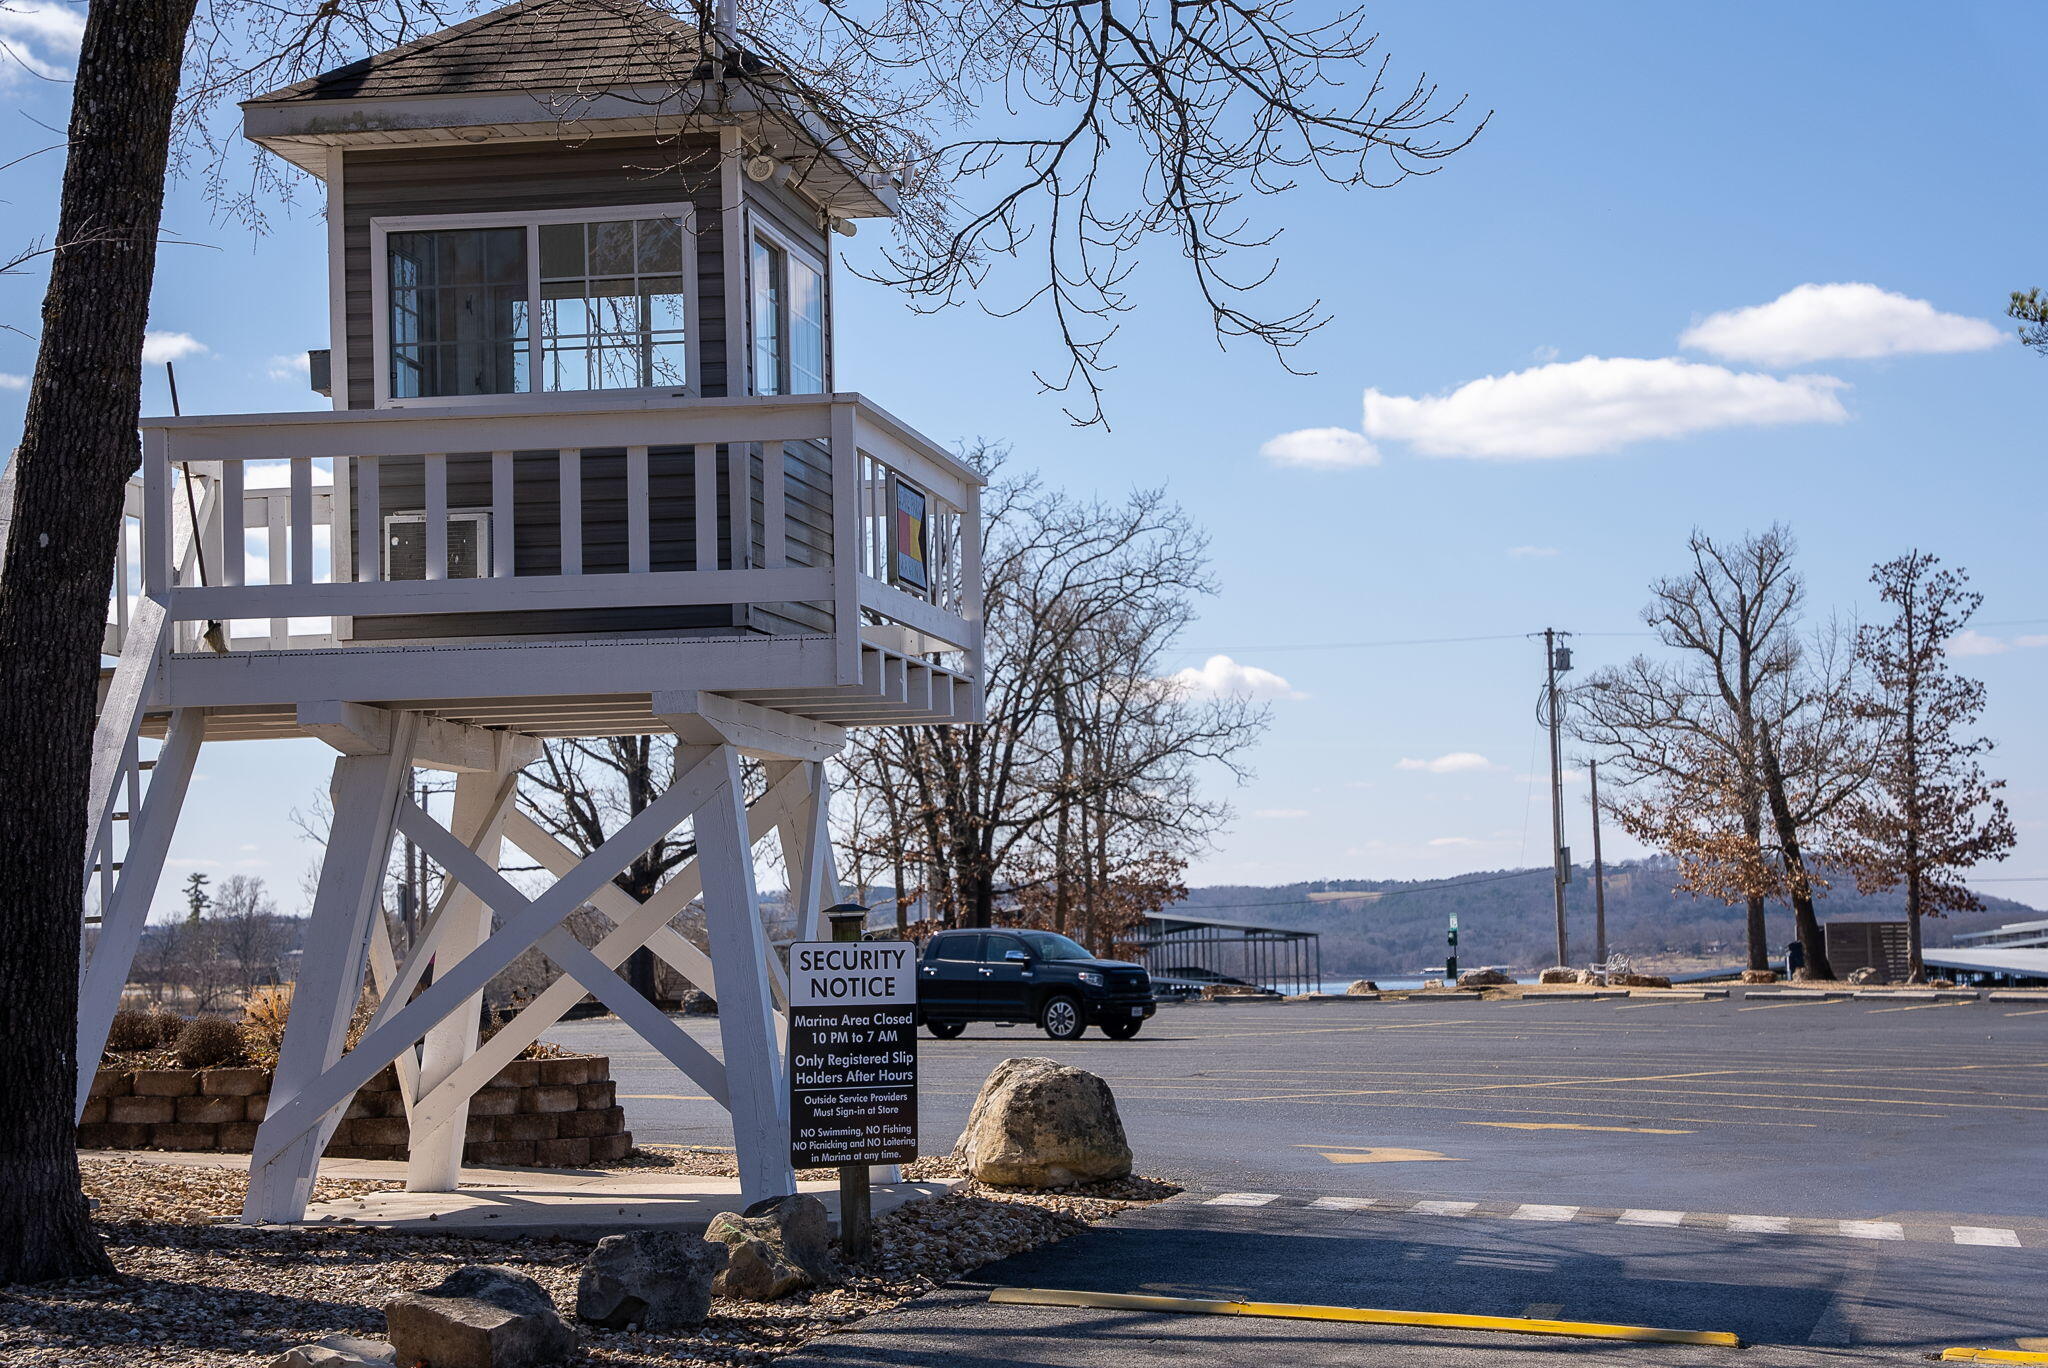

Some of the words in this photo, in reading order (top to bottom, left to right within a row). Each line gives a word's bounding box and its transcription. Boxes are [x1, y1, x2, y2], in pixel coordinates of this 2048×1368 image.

[800, 950, 905, 971] SECURITY
[811, 977, 896, 998] NOTICE
[795, 1015, 837, 1027] Marina
[842, 1014, 870, 1026] Area
[874, 1012, 912, 1025] Closed
[812, 1033, 826, 1045] 10
[831, 1032, 848, 1043] PM
[852, 1032, 863, 1043] to
[867, 1031, 874, 1042] 7
[878, 1030, 898, 1042] AM
[796, 1054, 824, 1069] Only
[828, 1053, 889, 1068] Registered
[892, 1051, 913, 1065] Slip
[797, 1072, 843, 1084] Holders
[847, 1071, 875, 1082] After
[879, 1070, 913, 1081] Hours
[804, 1095, 836, 1105] Outside
[839, 1094, 868, 1103] Service
[871, 1093, 908, 1102] Providers
[813, 1108, 833, 1117] Must
[836, 1107, 865, 1118] Sign-in
[868, 1107, 875, 1115] at
[878, 1106, 899, 1114] Store
[801, 1128, 815, 1137] NO
[818, 1127, 863, 1138] Swimming,
[866, 1125, 880, 1135] NO
[883, 1124, 911, 1136] Fishing
[793, 1142, 807, 1150] NO
[809, 1140, 847, 1151] Picnicking
[850, 1140, 864, 1148] and
[867, 1138, 881, 1147] NO
[883, 1137, 916, 1149] Loitering
[811, 1154, 819, 1162] in
[822, 1153, 851, 1161] Marina
[854, 1152, 861, 1161] at
[864, 1153, 879, 1162] any
[882, 1151, 901, 1159] time.
